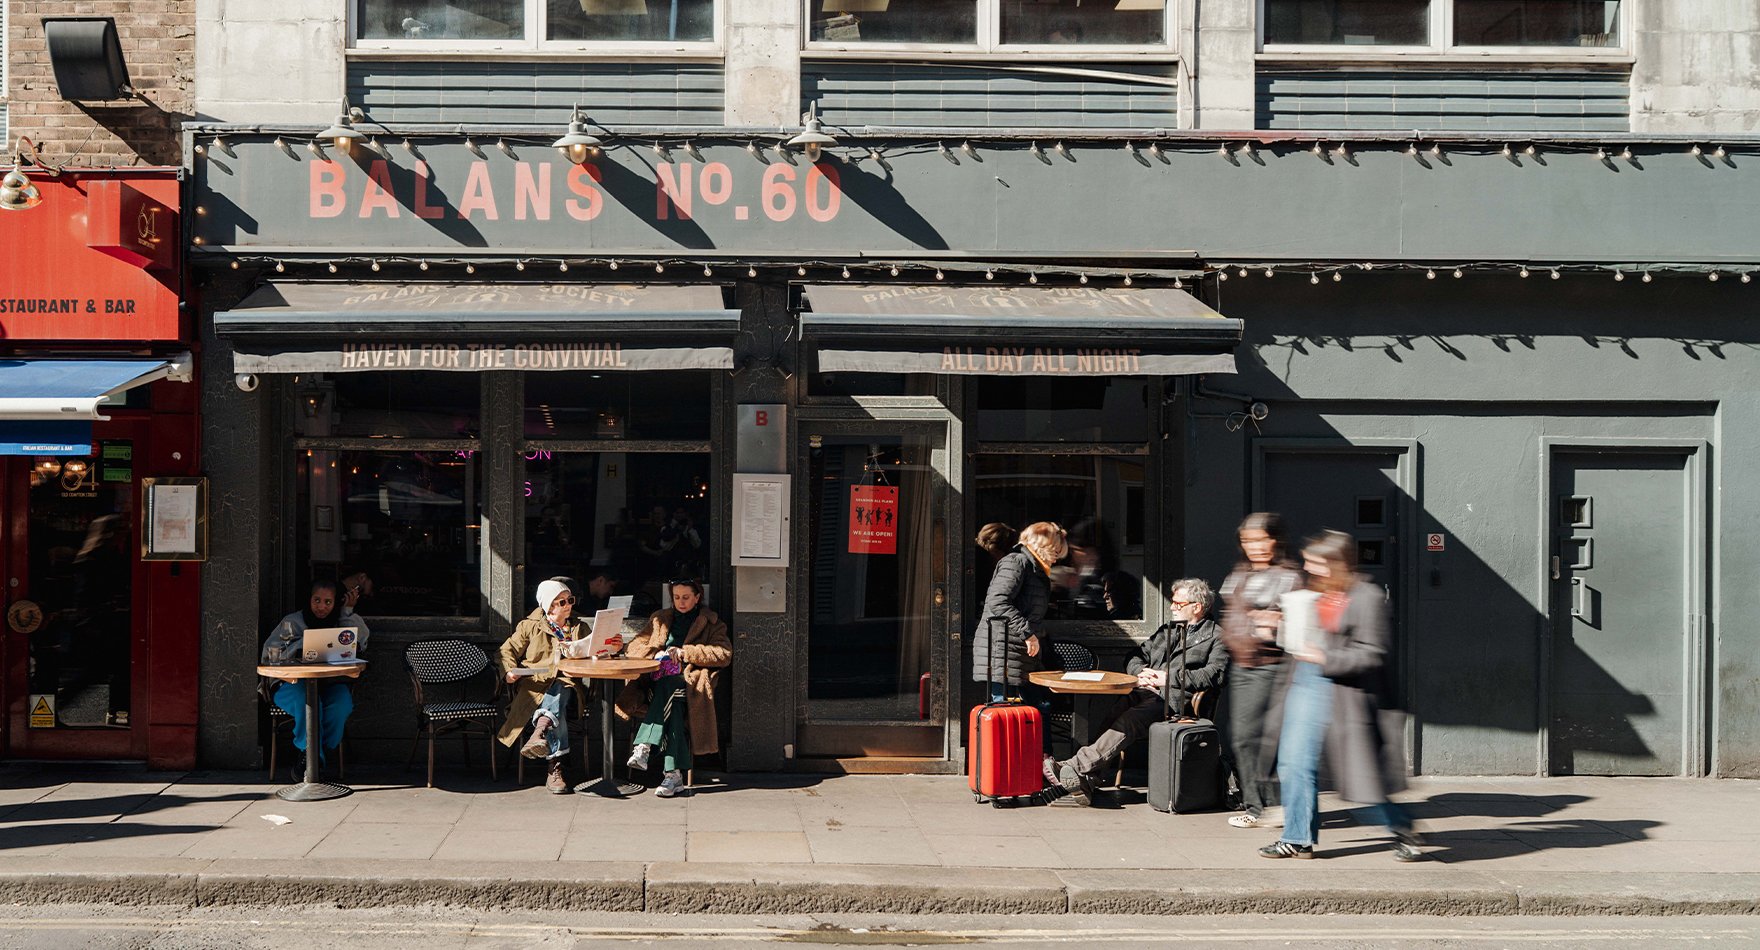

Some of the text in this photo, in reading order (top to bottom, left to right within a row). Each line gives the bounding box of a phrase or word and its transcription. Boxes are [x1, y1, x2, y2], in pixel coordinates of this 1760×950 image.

[309, 159, 603, 222] BALANS
[0, 299, 136, 314] STAURANT & BAR
[342, 342, 627, 369] HAVEN FOR THE CONVIVIAL
[941, 346, 1141, 373] ALL DAY ALL NIGHT
[756, 410, 768, 426] B
